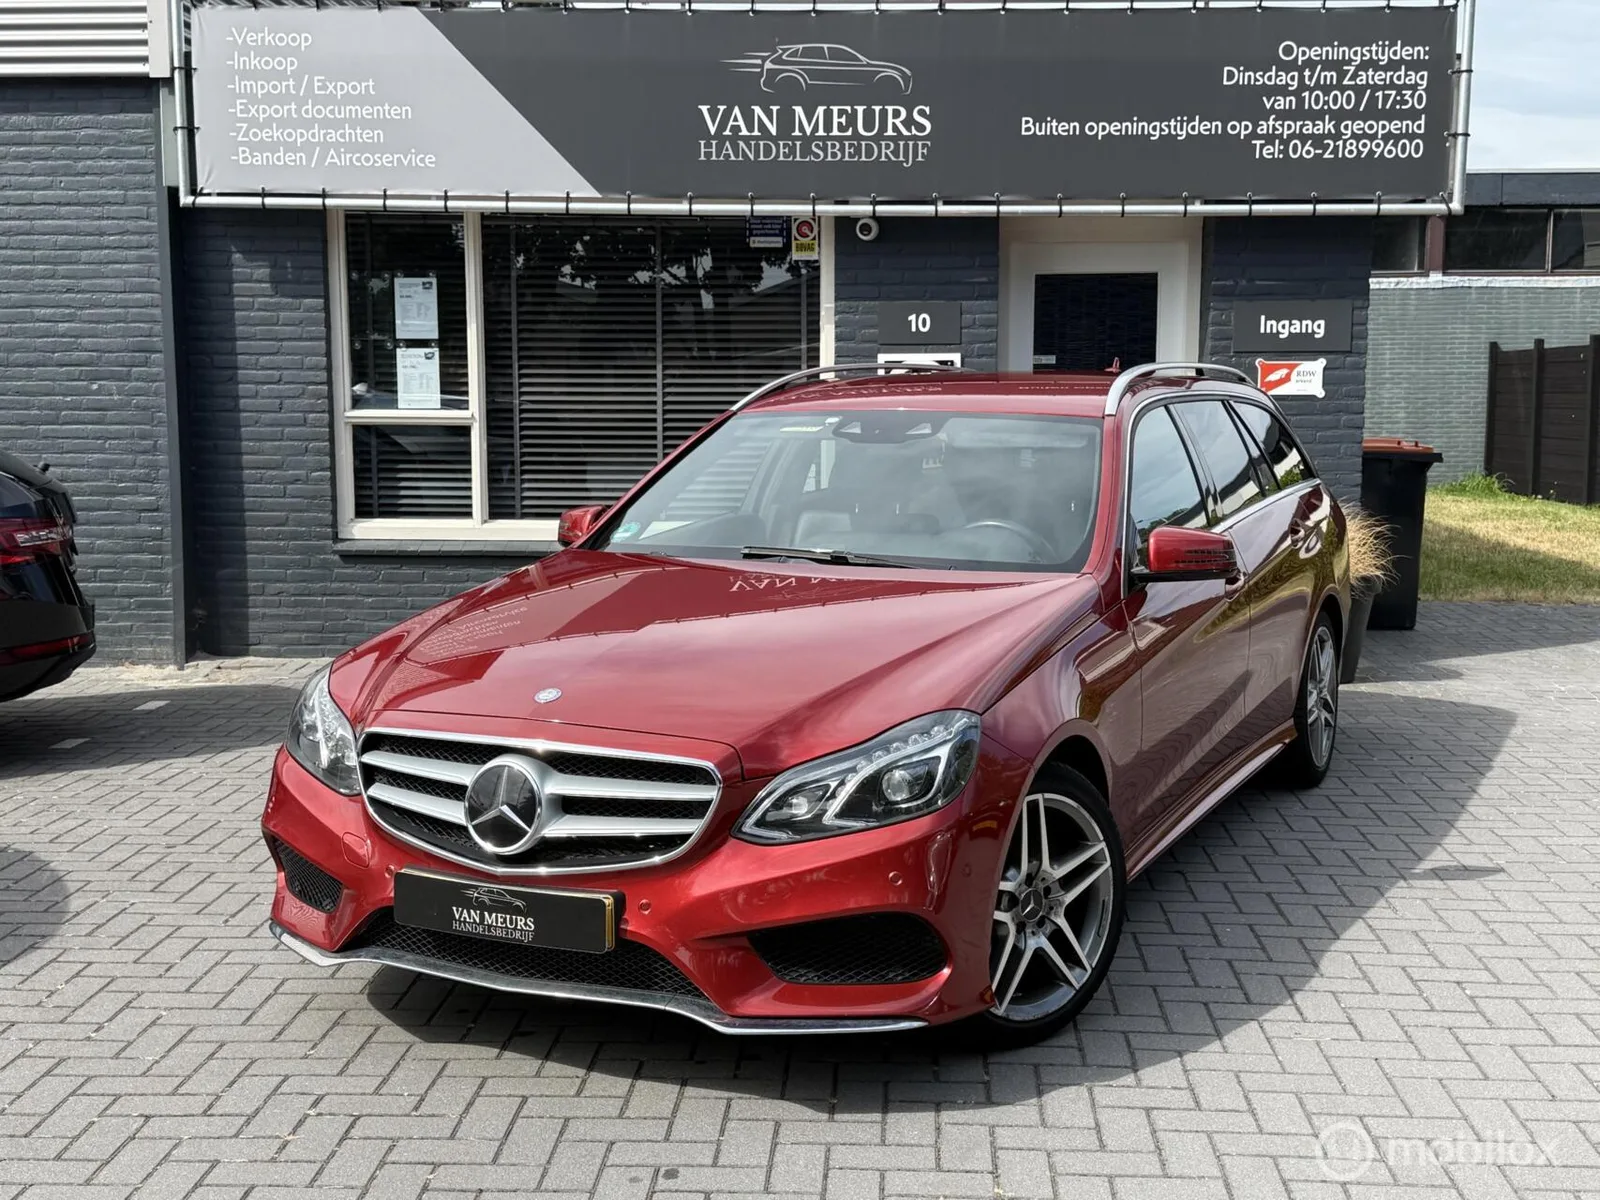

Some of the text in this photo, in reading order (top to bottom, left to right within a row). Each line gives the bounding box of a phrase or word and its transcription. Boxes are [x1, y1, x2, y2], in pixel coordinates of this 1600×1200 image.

[225, 27, 312, 52] -Verkoop
[226, 51, 298, 76] -Inkoop
[1278, 39, 1430, 66] Openingstijden:
[227, 74, 376, 100] -Import / Export
[1222, 64, 1428, 91] Dinsdag t/m Zaterdag
[227, 98, 412, 123] -Export documenten
[1262, 88, 1427, 112] van 10:00 / 17:30
[697, 104, 932, 137] VAN MEURS
[1021, 114, 1426, 141] Buiten openingstijden op afspraak geopend
[229, 122, 384, 147] -Zoekopdrachten
[230, 146, 436, 168] -Banden / Aircoservice
[698, 140, 931, 168] HANDELSBEDRIJF
[1251, 138, 1424, 159] Tel: 06-21899600
[907, 313, 931, 333] 10
[1259, 314, 1326, 339] Ingang
[452, 906, 535, 931] VAN MEURS
[452, 920, 535, 942] HANDELSBEDRIJF
